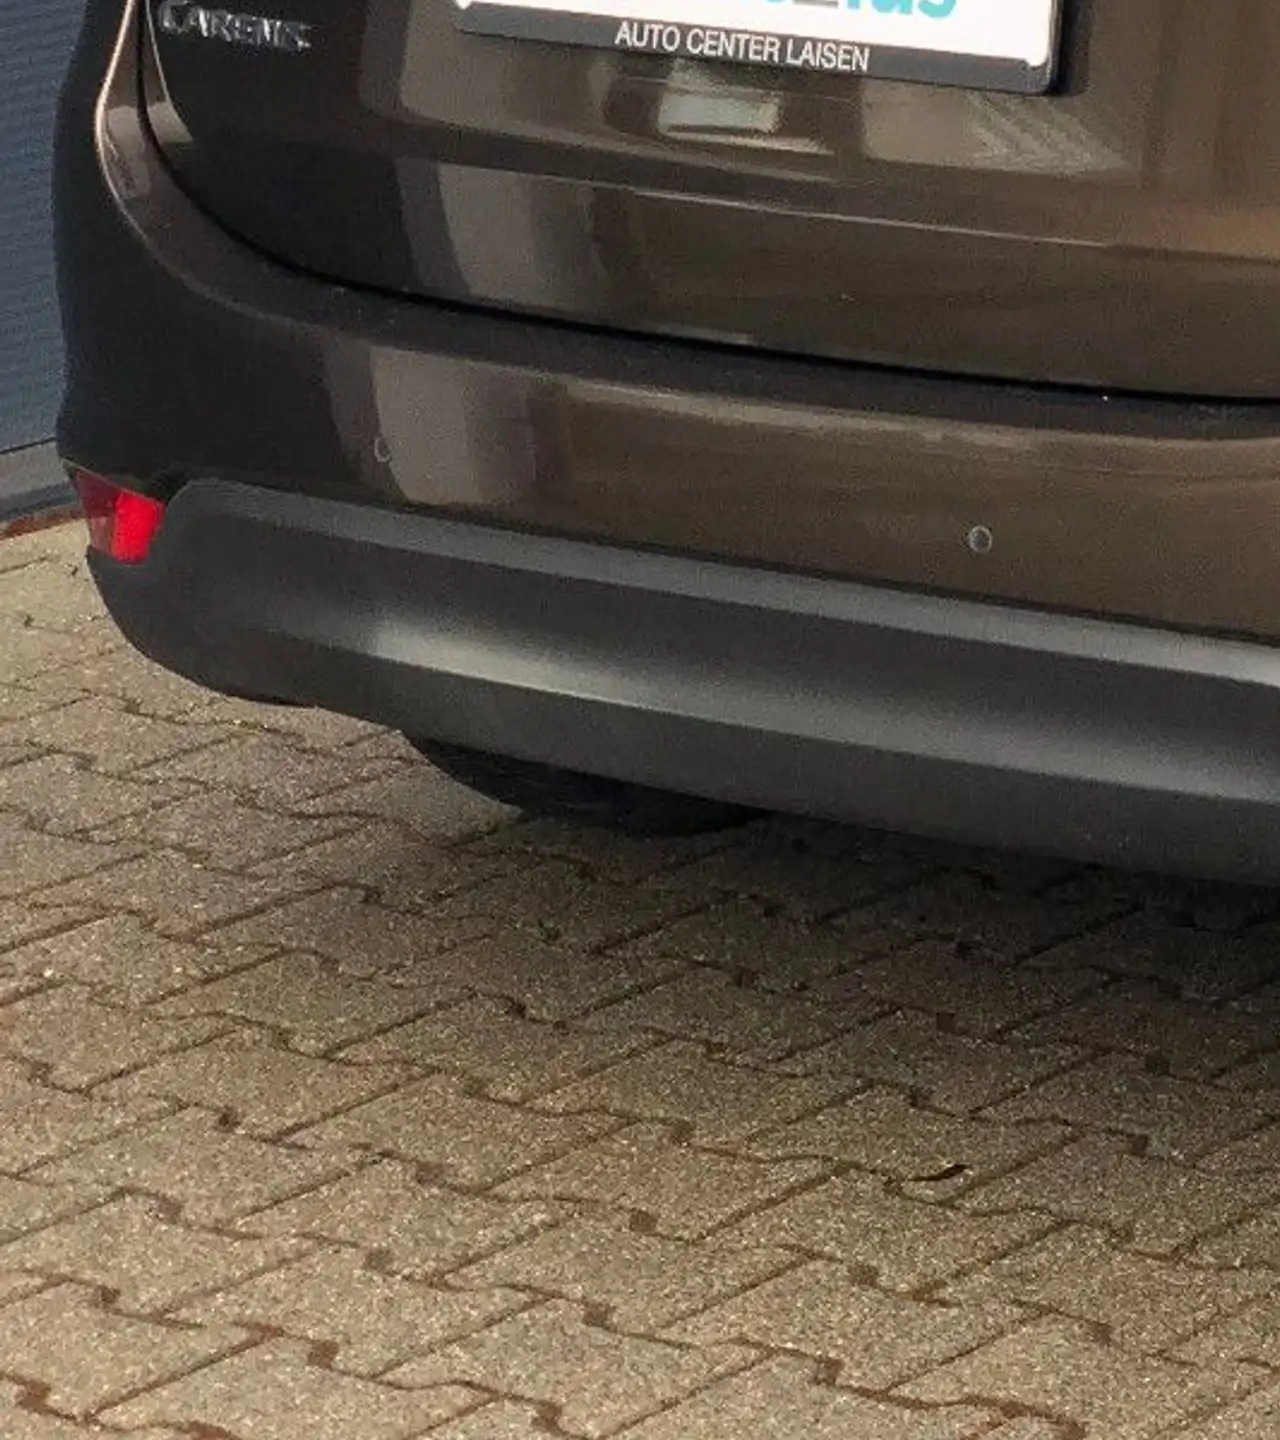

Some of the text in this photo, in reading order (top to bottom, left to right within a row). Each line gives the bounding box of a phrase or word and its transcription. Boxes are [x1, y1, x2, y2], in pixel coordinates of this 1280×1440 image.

[614, 20, 871, 73] AUTO CENTER LAISEN
